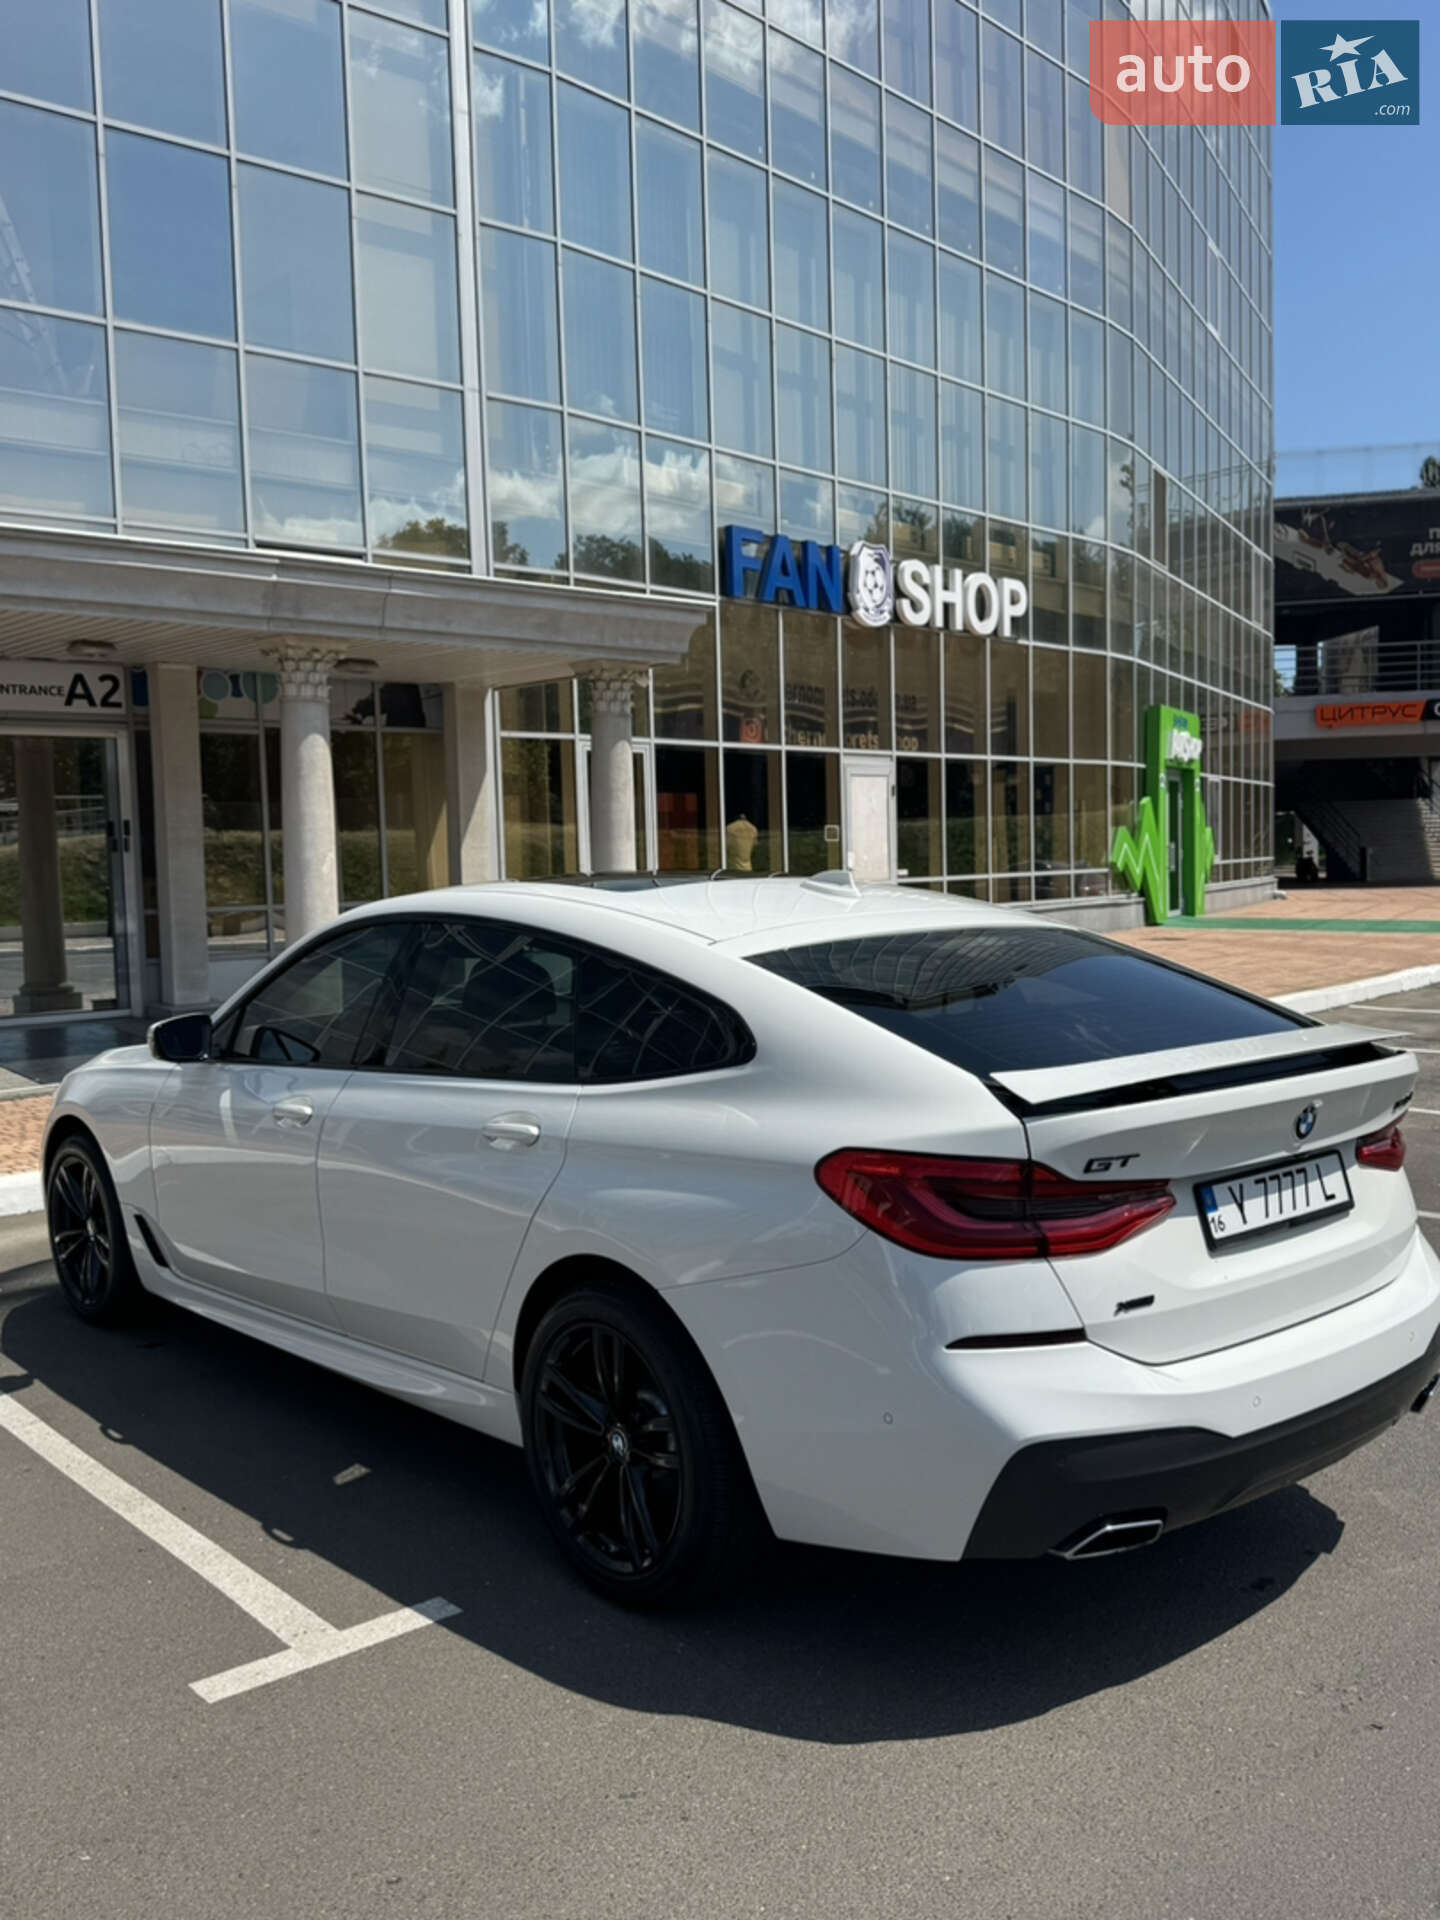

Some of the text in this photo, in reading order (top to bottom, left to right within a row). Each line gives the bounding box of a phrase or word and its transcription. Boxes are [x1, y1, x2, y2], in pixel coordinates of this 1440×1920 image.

[725, 524, 1029, 638] FAN SHOP
[64, 672, 123, 709] A2
[1320, 702, 1418, 722] ЦИТРУС
[1083, 1152, 1141, 1174] GT
[1254, 1167, 1311, 1219] 7777
[1315, 1163, 1337, 1202] L
[1210, 1214, 1226, 1233] 16
